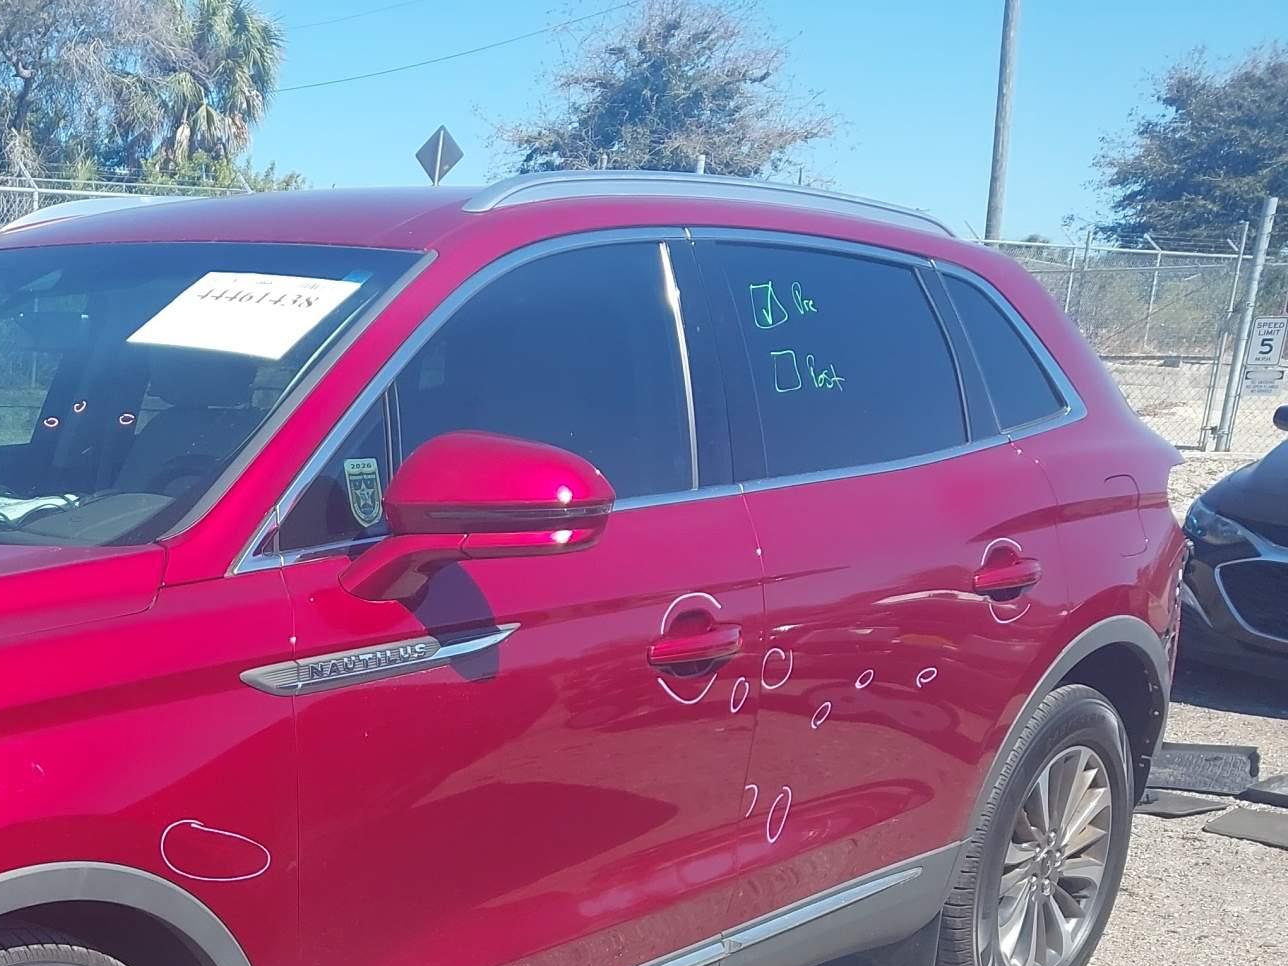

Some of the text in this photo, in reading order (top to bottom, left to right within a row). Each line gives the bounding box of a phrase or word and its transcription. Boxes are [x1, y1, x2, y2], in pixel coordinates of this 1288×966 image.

[791, 281, 818, 315] Pre
[1256, 321, 1285, 329] SPEED
[1258, 329, 1280, 337] LIMIT
[1258, 338, 1274, 355] 5
[308, 643, 427, 680] NAUTILUS
